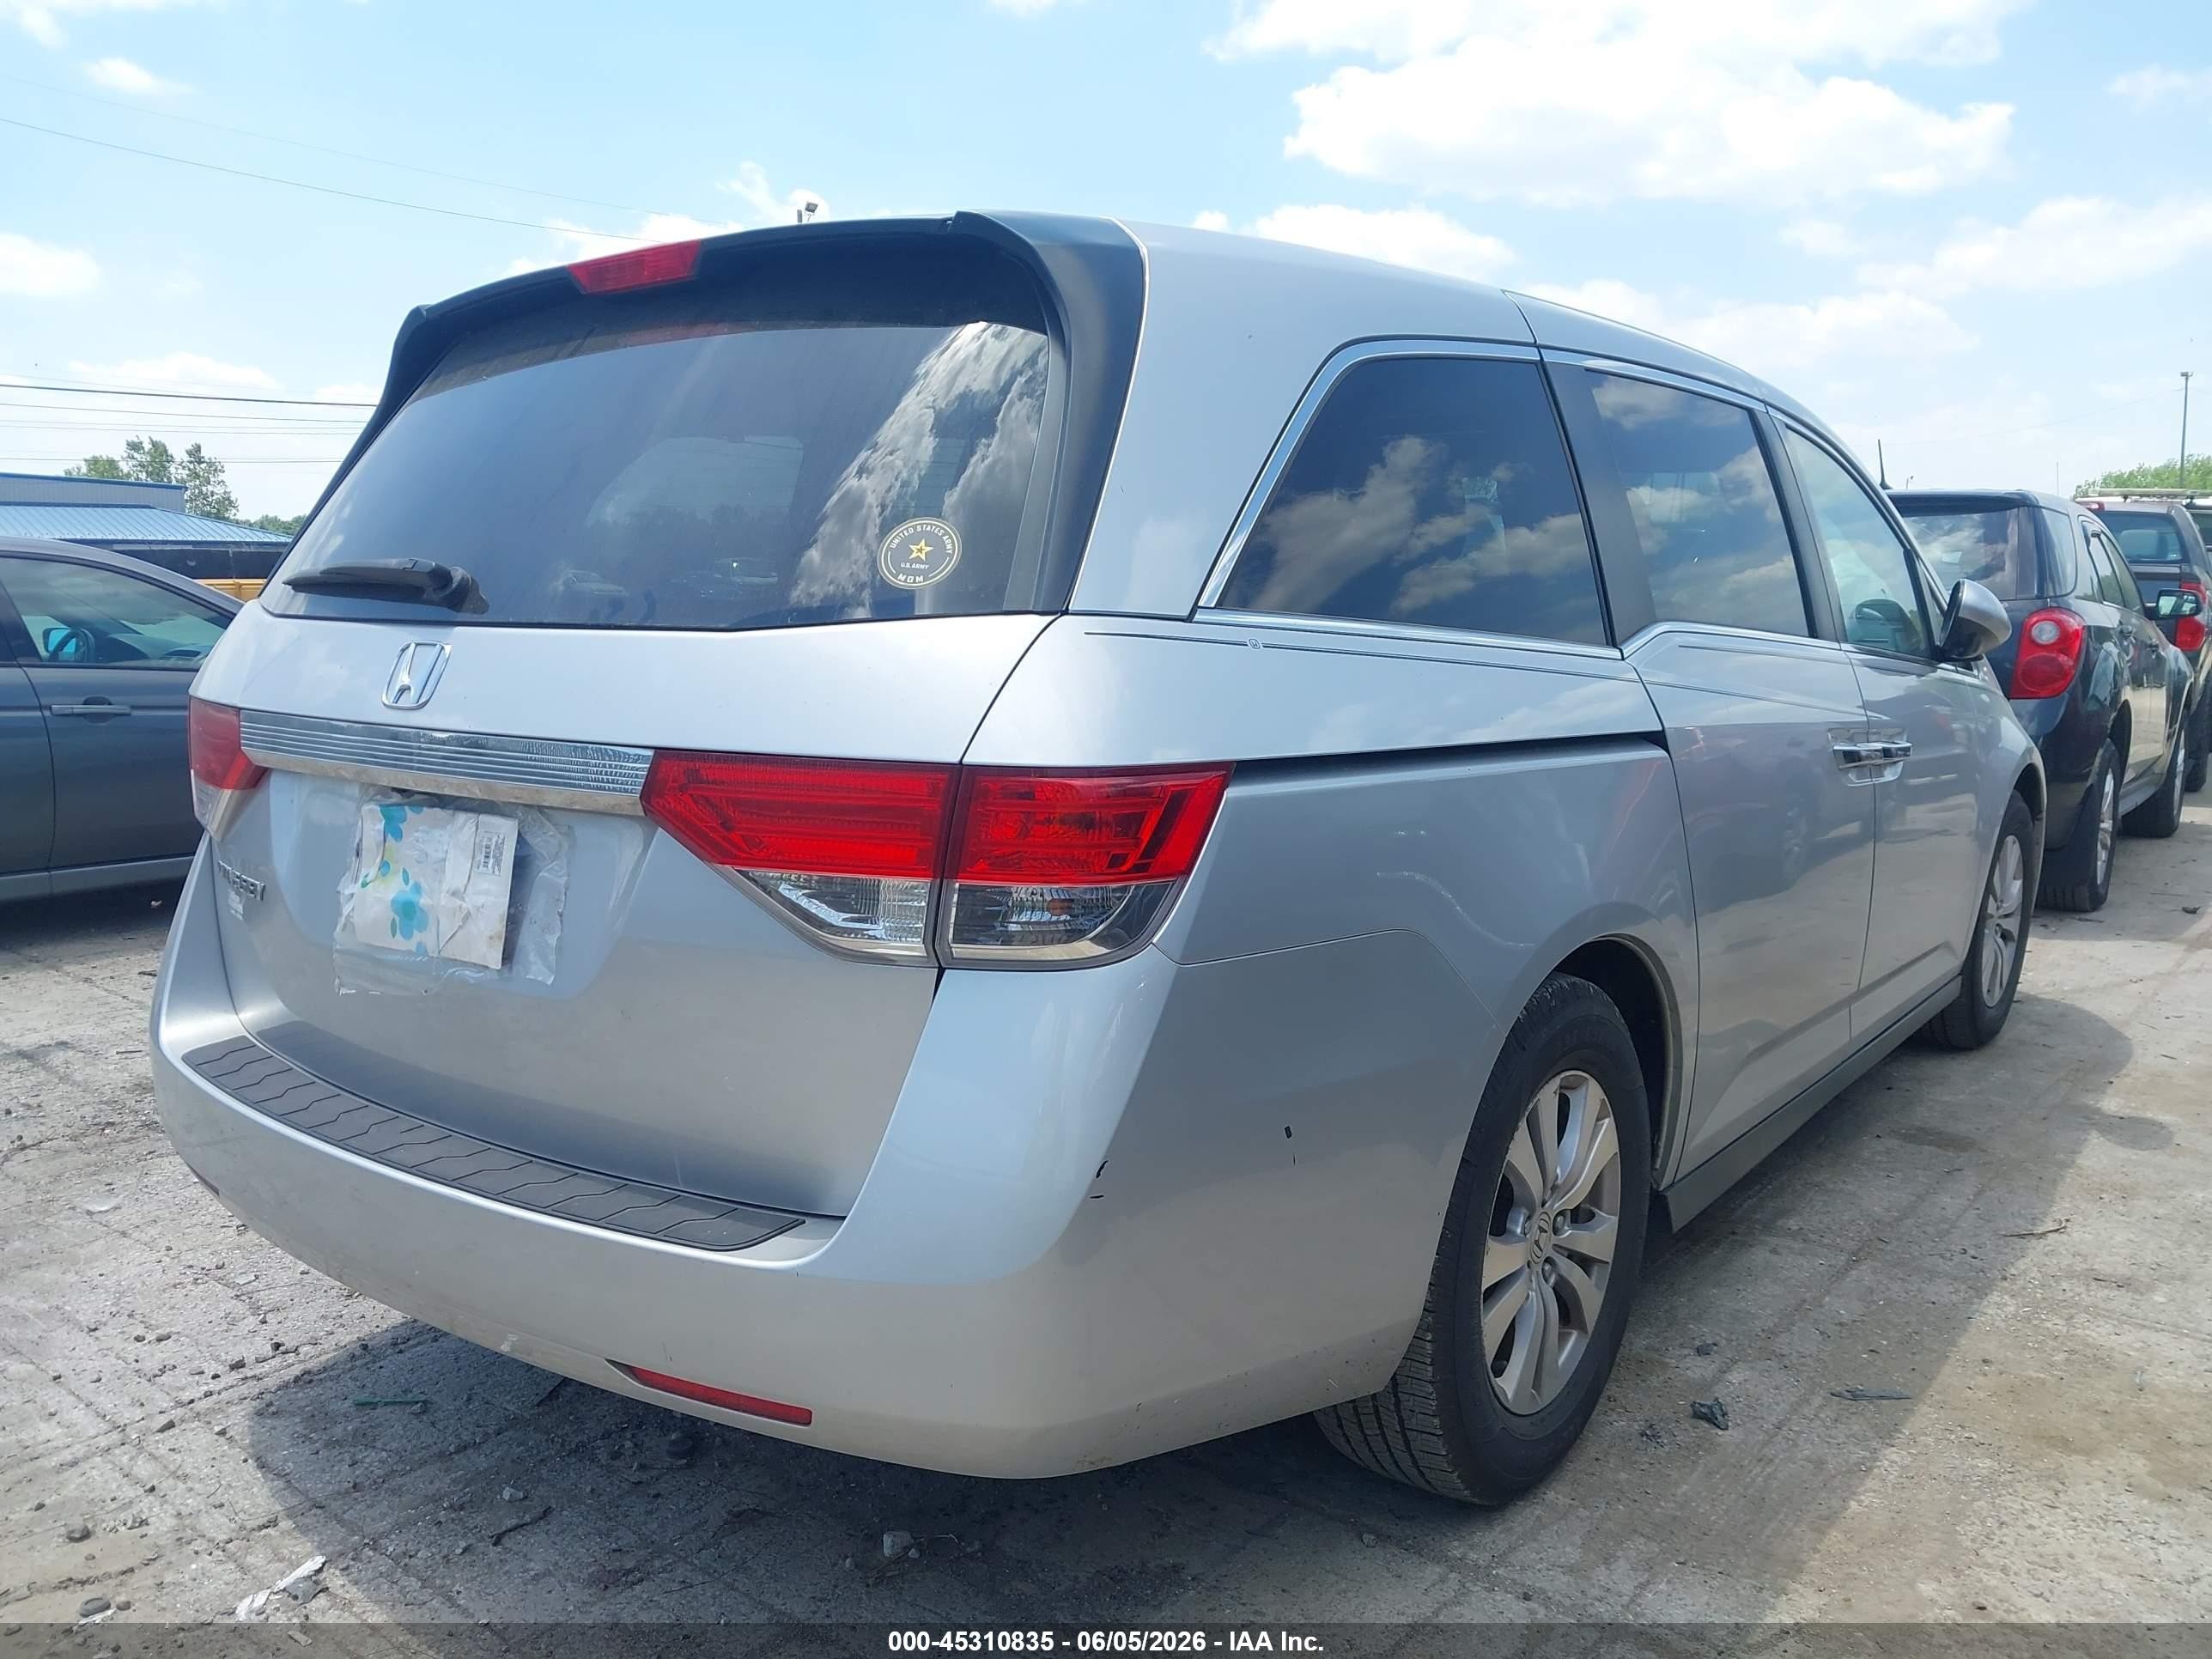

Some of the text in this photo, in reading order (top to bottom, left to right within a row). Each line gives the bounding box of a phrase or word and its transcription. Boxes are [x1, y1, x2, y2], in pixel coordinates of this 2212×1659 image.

[890, 524, 953, 554] UNITED STATES ARMY
[897, 573, 924, 583] MOM
